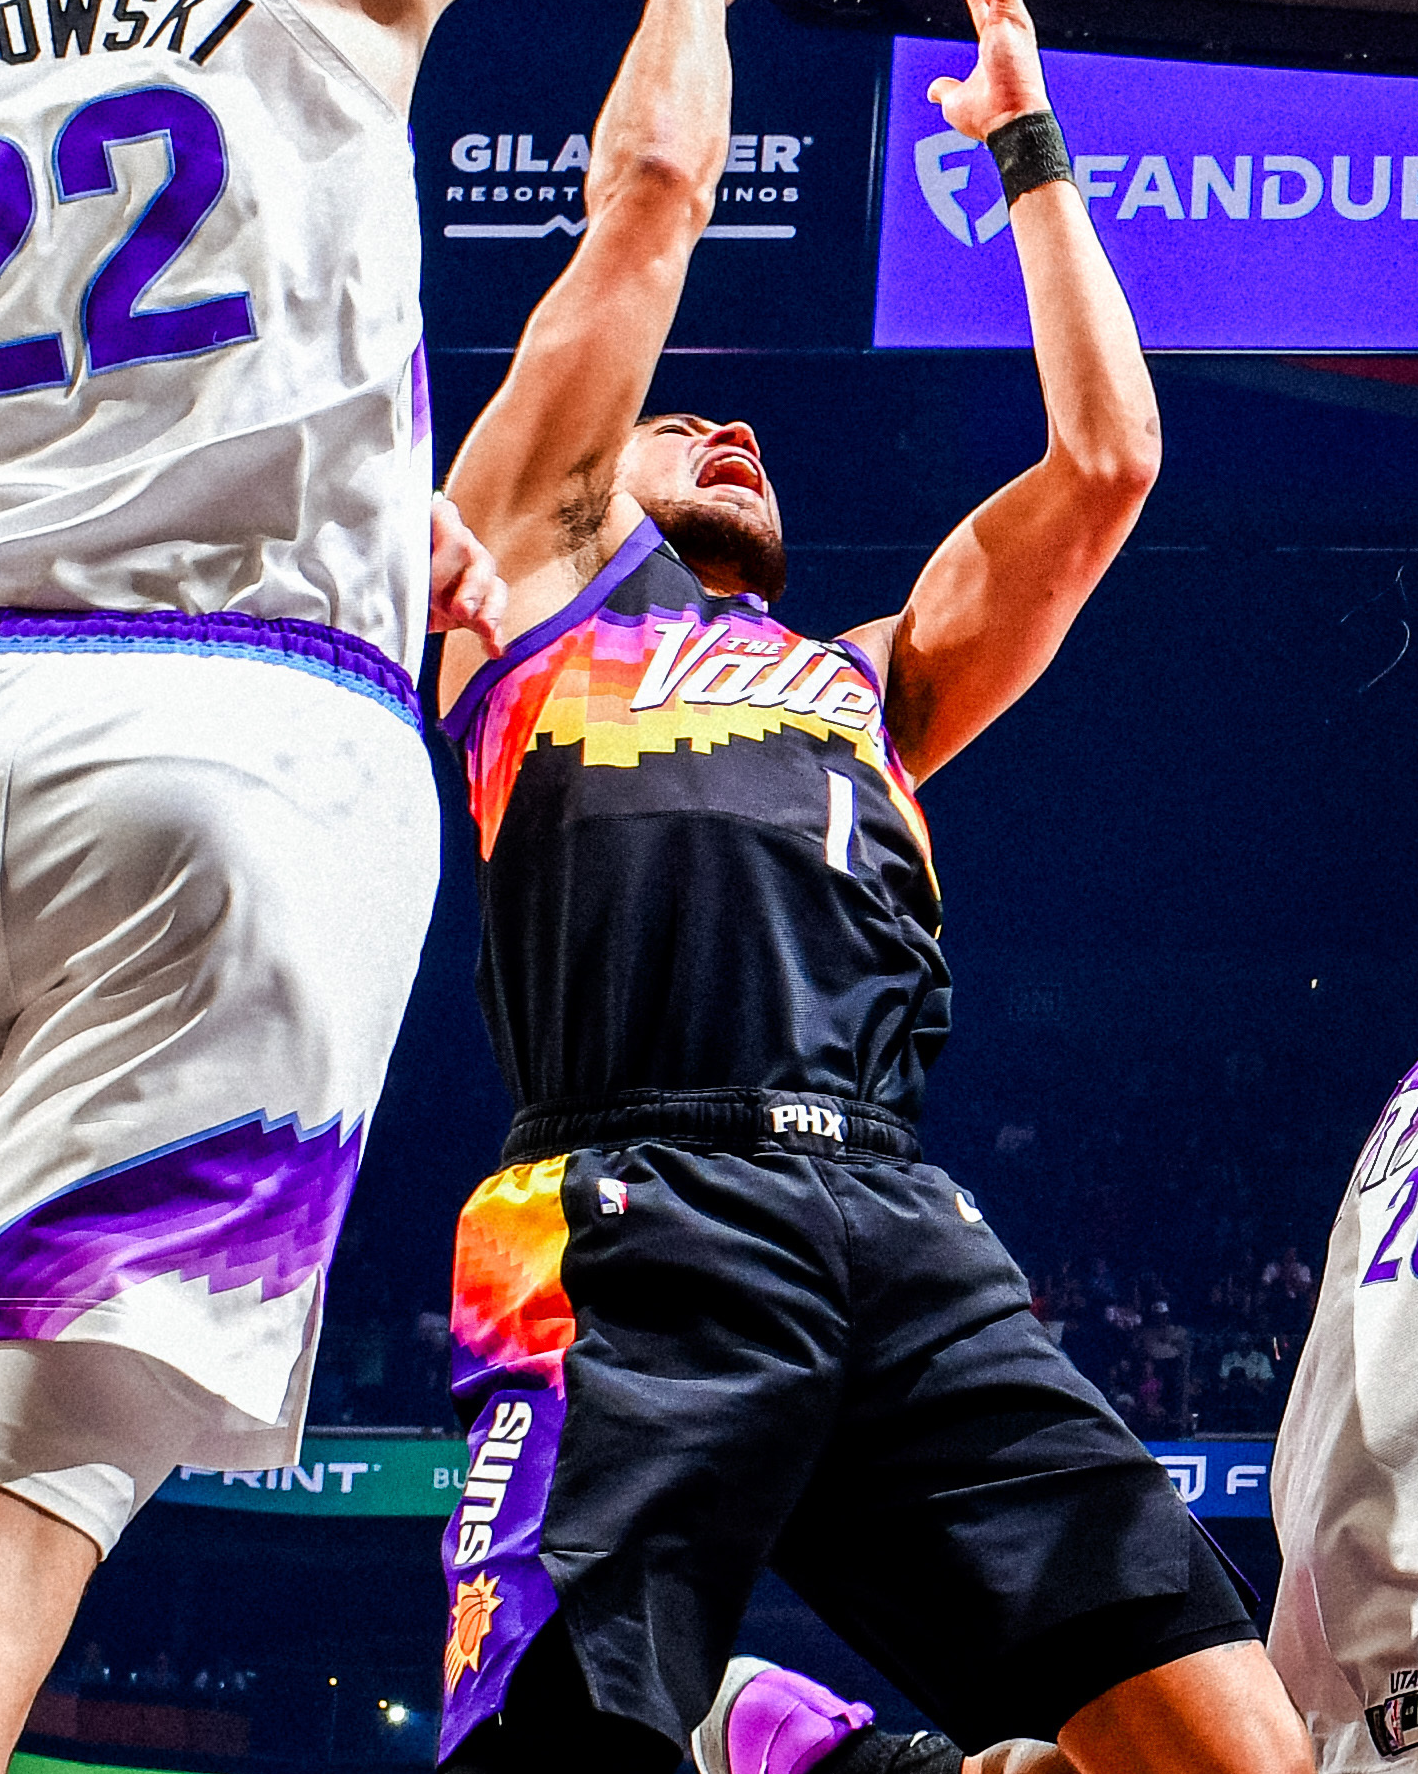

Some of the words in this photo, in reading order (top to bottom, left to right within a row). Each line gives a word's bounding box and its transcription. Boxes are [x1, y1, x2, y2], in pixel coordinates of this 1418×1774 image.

[450, 133, 591, 173] GILA
[728, 637, 787, 655] THE
[823, 767, 857, 879] 1
[770, 1104, 845, 1143] PHX
[454, 1402, 533, 1565] SUNS
